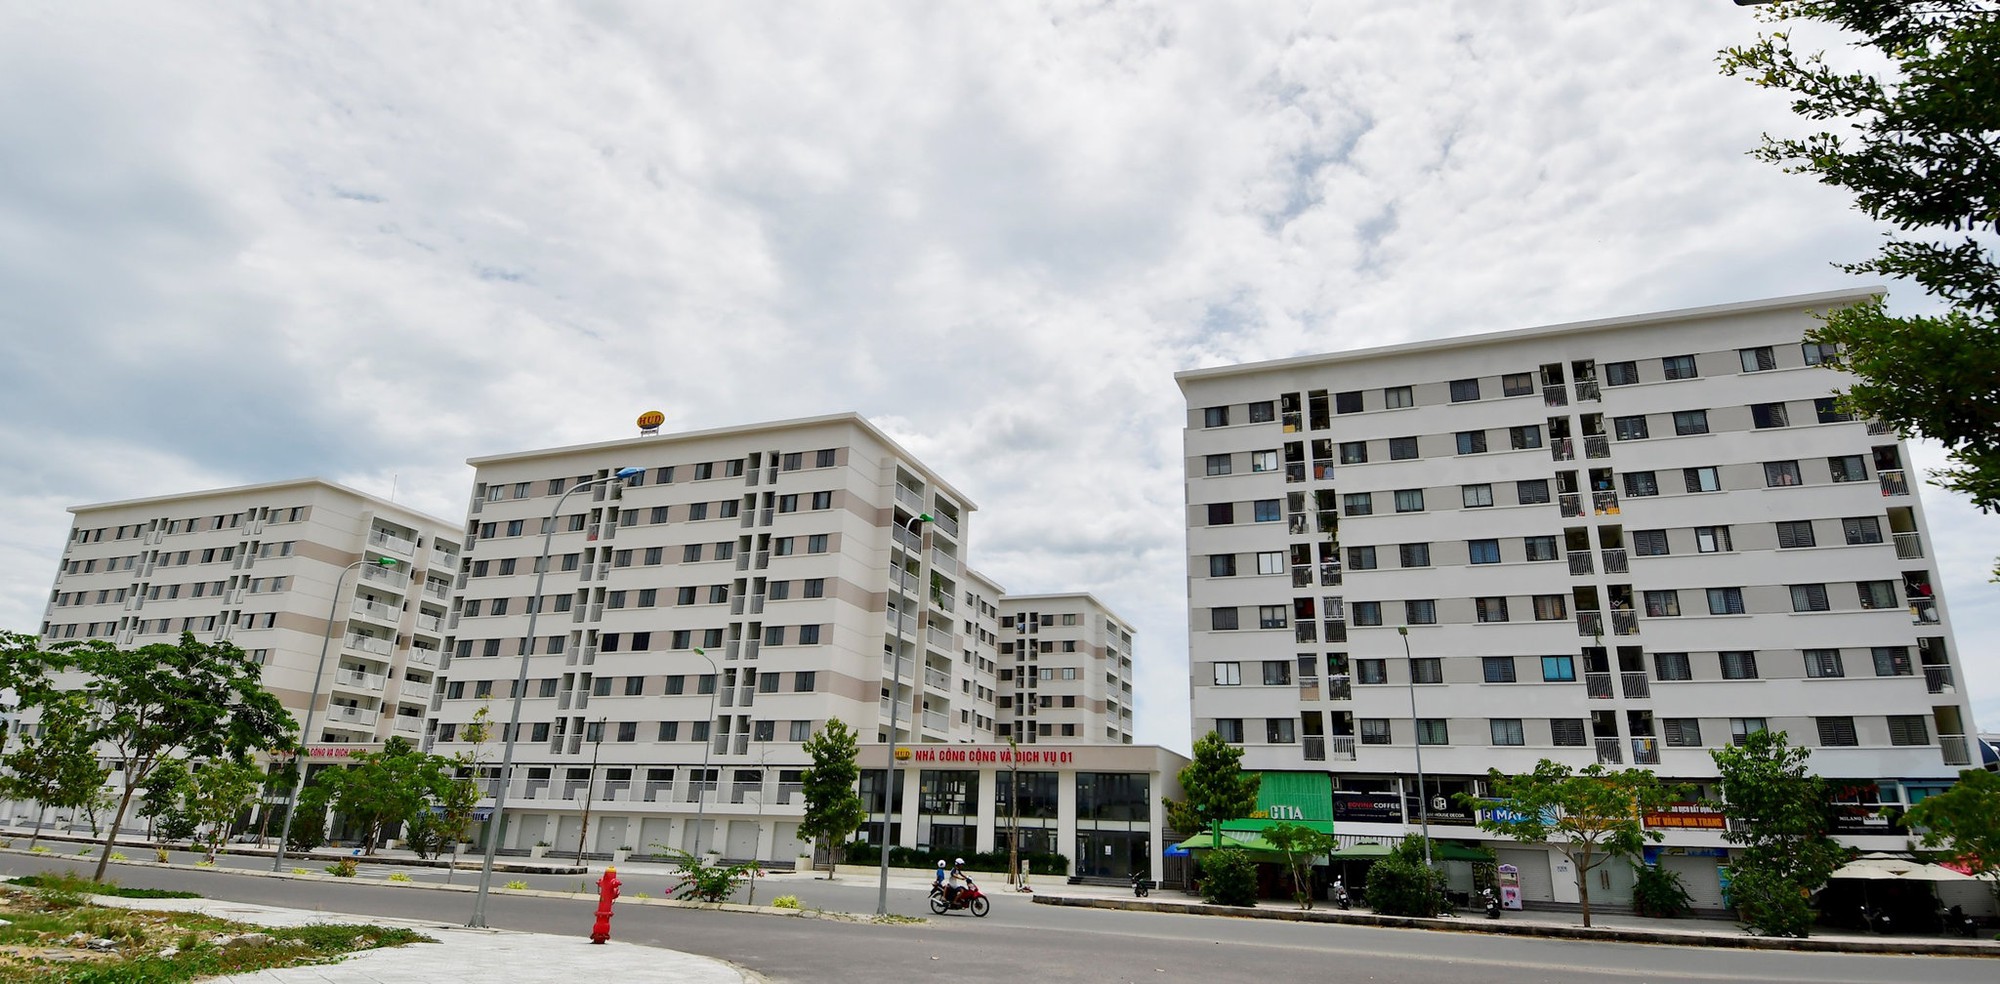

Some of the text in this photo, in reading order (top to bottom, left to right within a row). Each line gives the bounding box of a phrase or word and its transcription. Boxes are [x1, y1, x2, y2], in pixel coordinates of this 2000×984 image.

[639, 414, 662, 426] HUD
[915, 747, 1073, 766] NHÀ CÔNG CỘNG VÀ DỊCH VỤ 01
[1270, 804, 1304, 820] CT1A
